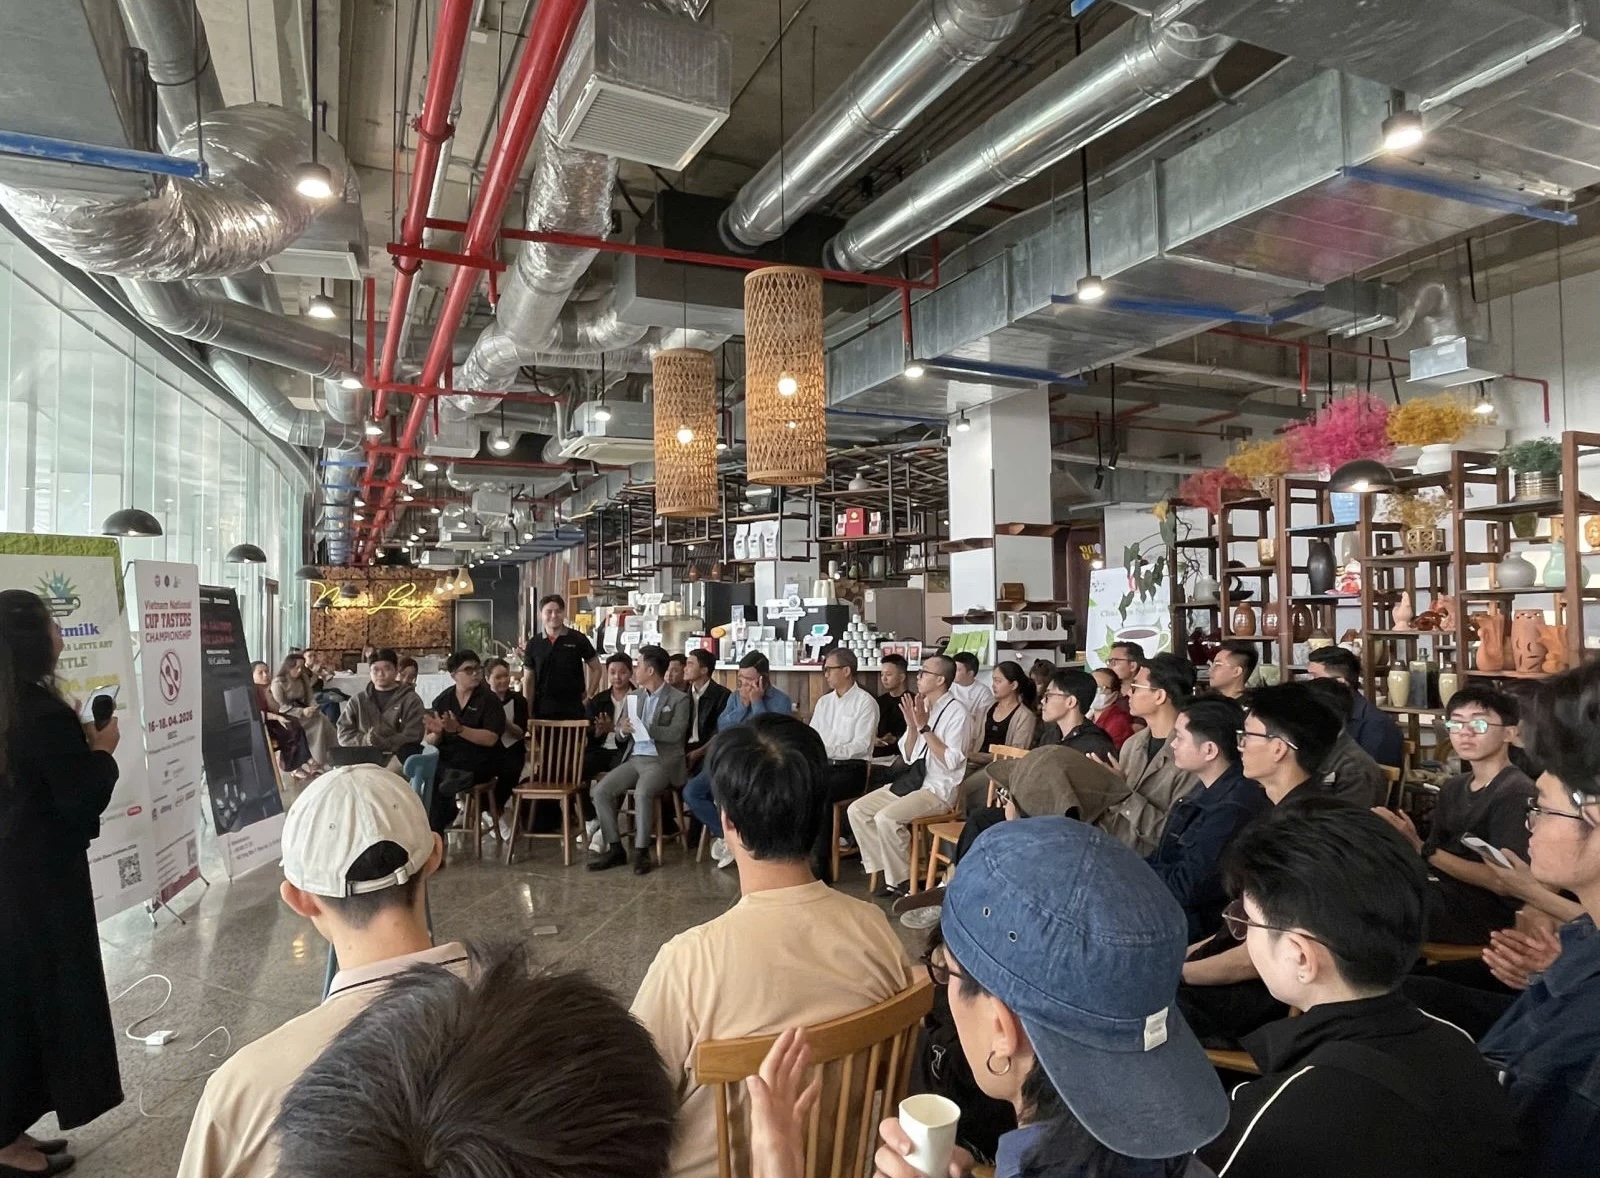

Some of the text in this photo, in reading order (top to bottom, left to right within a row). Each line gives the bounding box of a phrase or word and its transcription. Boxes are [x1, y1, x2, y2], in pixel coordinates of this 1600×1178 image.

[144, 613, 159, 628] CUP
[161, 612, 191, 628] TASTERS
[145, 630, 192, 643] CHAMPIONSHIP
[74, 641, 97, 651] LATTE
[99, 640, 113, 649] ART
